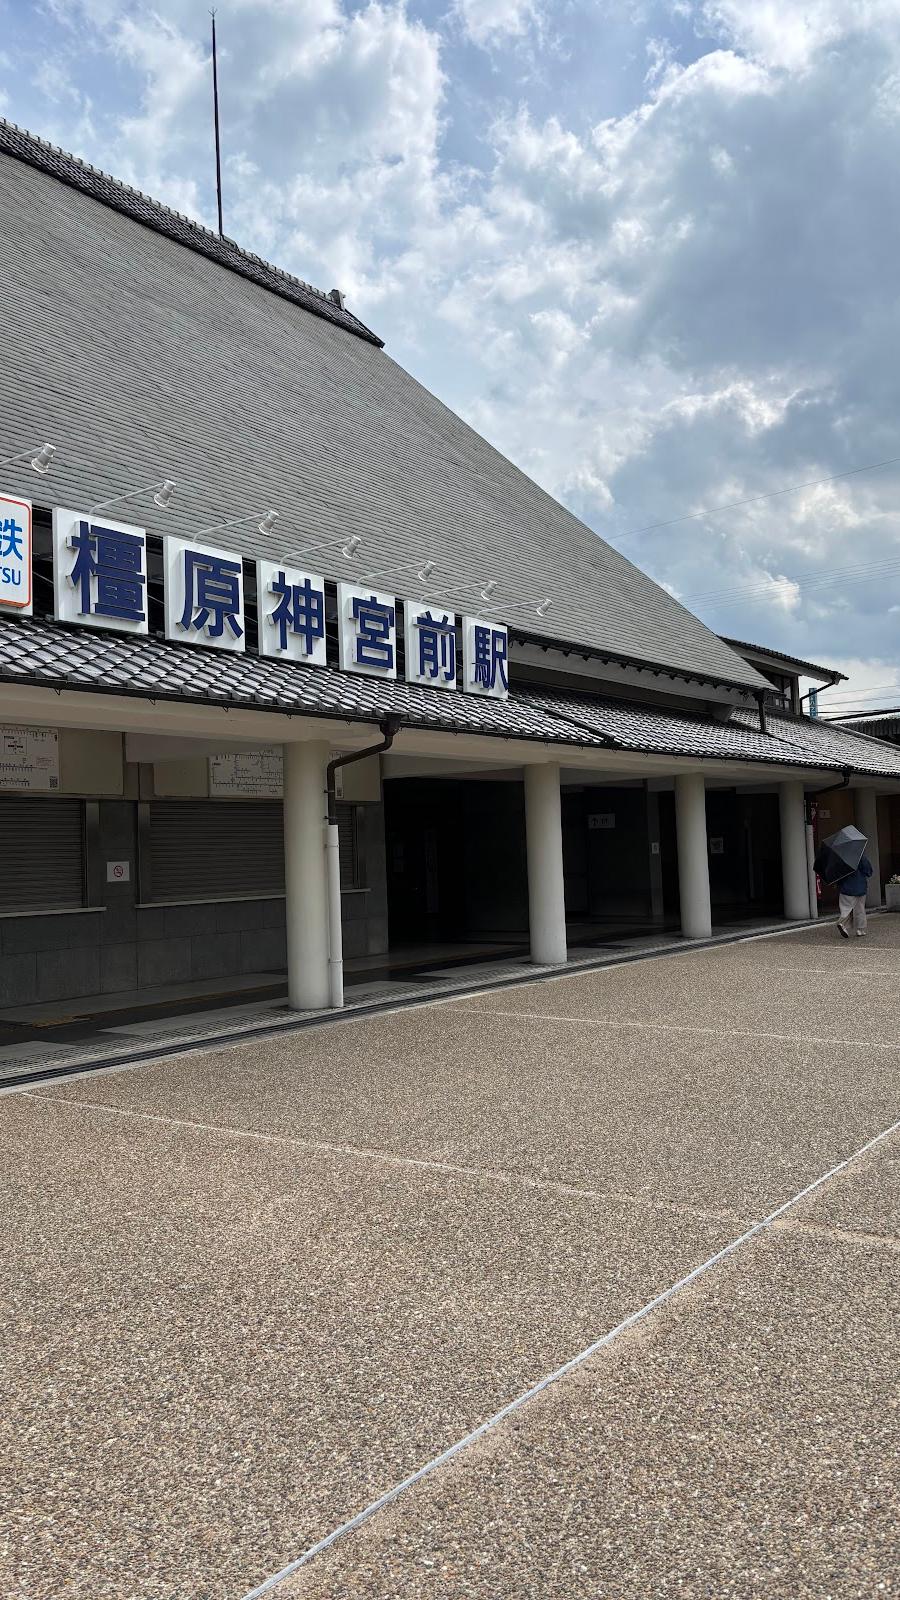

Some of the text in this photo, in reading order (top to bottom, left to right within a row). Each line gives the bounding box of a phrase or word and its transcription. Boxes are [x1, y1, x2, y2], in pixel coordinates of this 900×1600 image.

[0, 566, 21, 586] SU
[68, 520, 509, 691] 橿原神宮前駅
